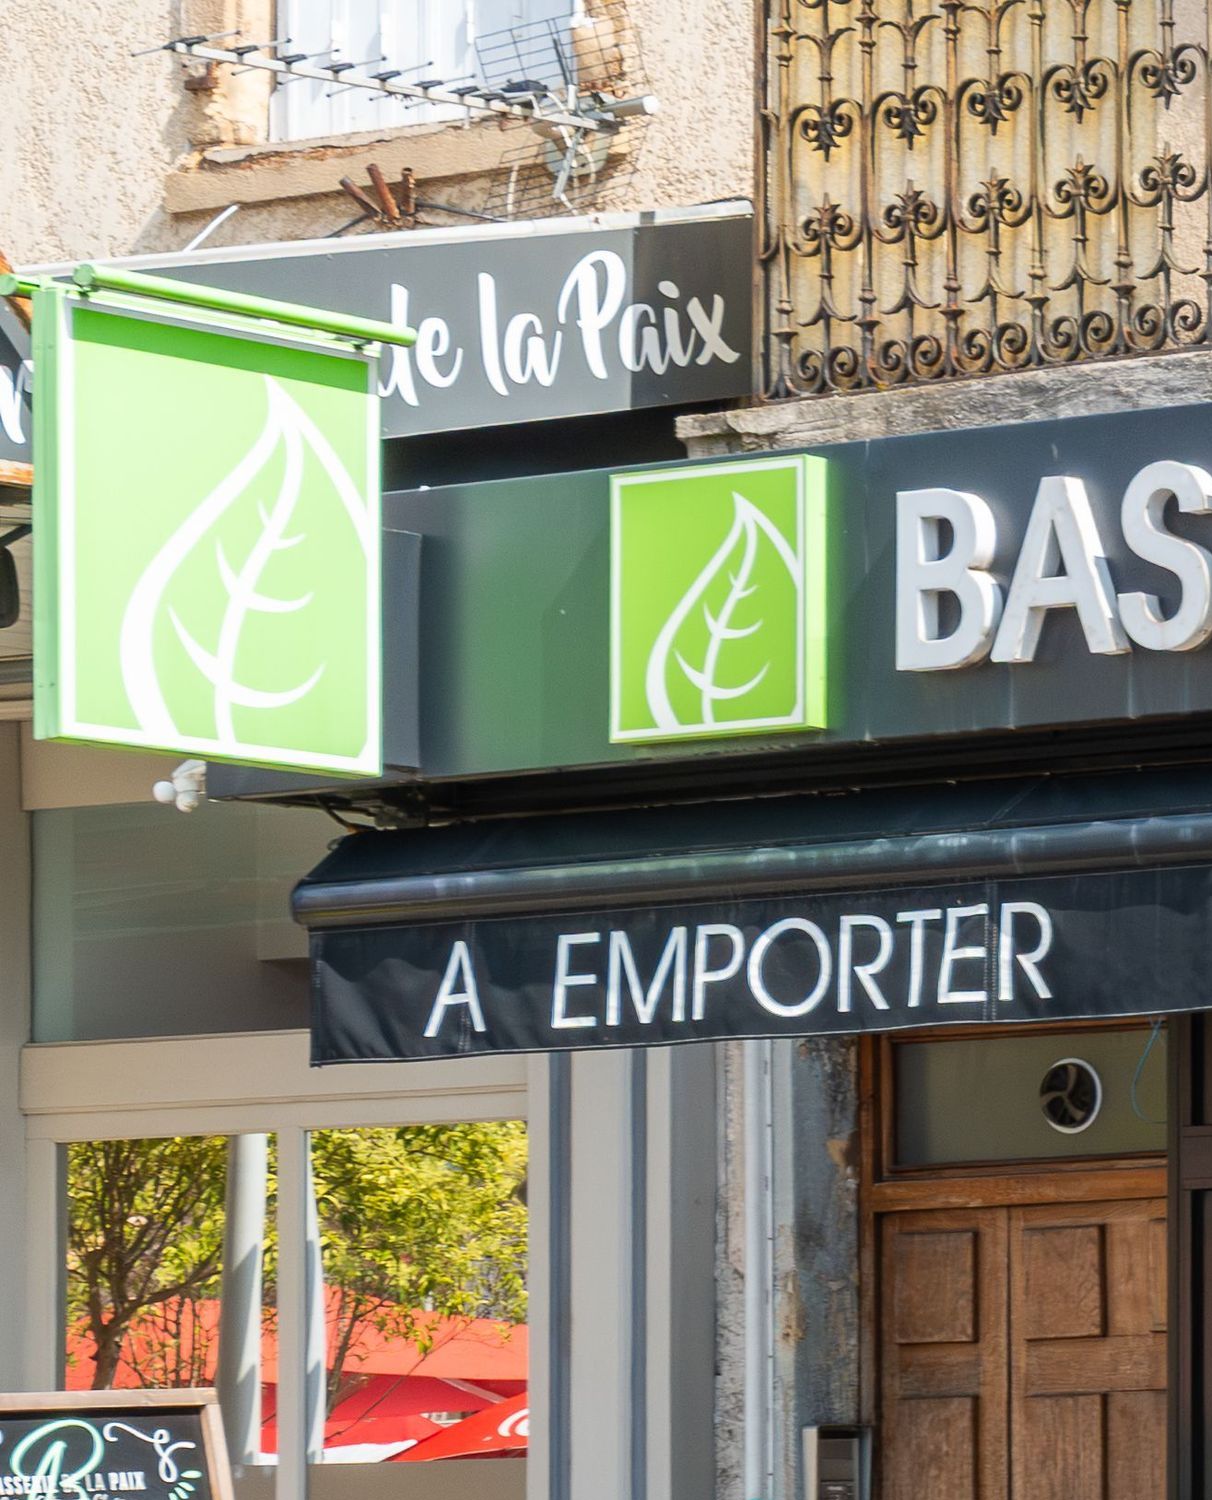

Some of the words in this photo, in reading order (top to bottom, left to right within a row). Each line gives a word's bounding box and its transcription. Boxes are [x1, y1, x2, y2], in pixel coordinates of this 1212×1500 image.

[379, 283, 463, 406] de
[478, 272, 562, 395] la
[558, 250, 741, 380] Paix
[424, 940, 487, 1037] A
[551, 901, 1053, 1029] EMPORTER
[84, 1472, 107, 1492] LA
[107, 1470, 147, 1491] PAIX
